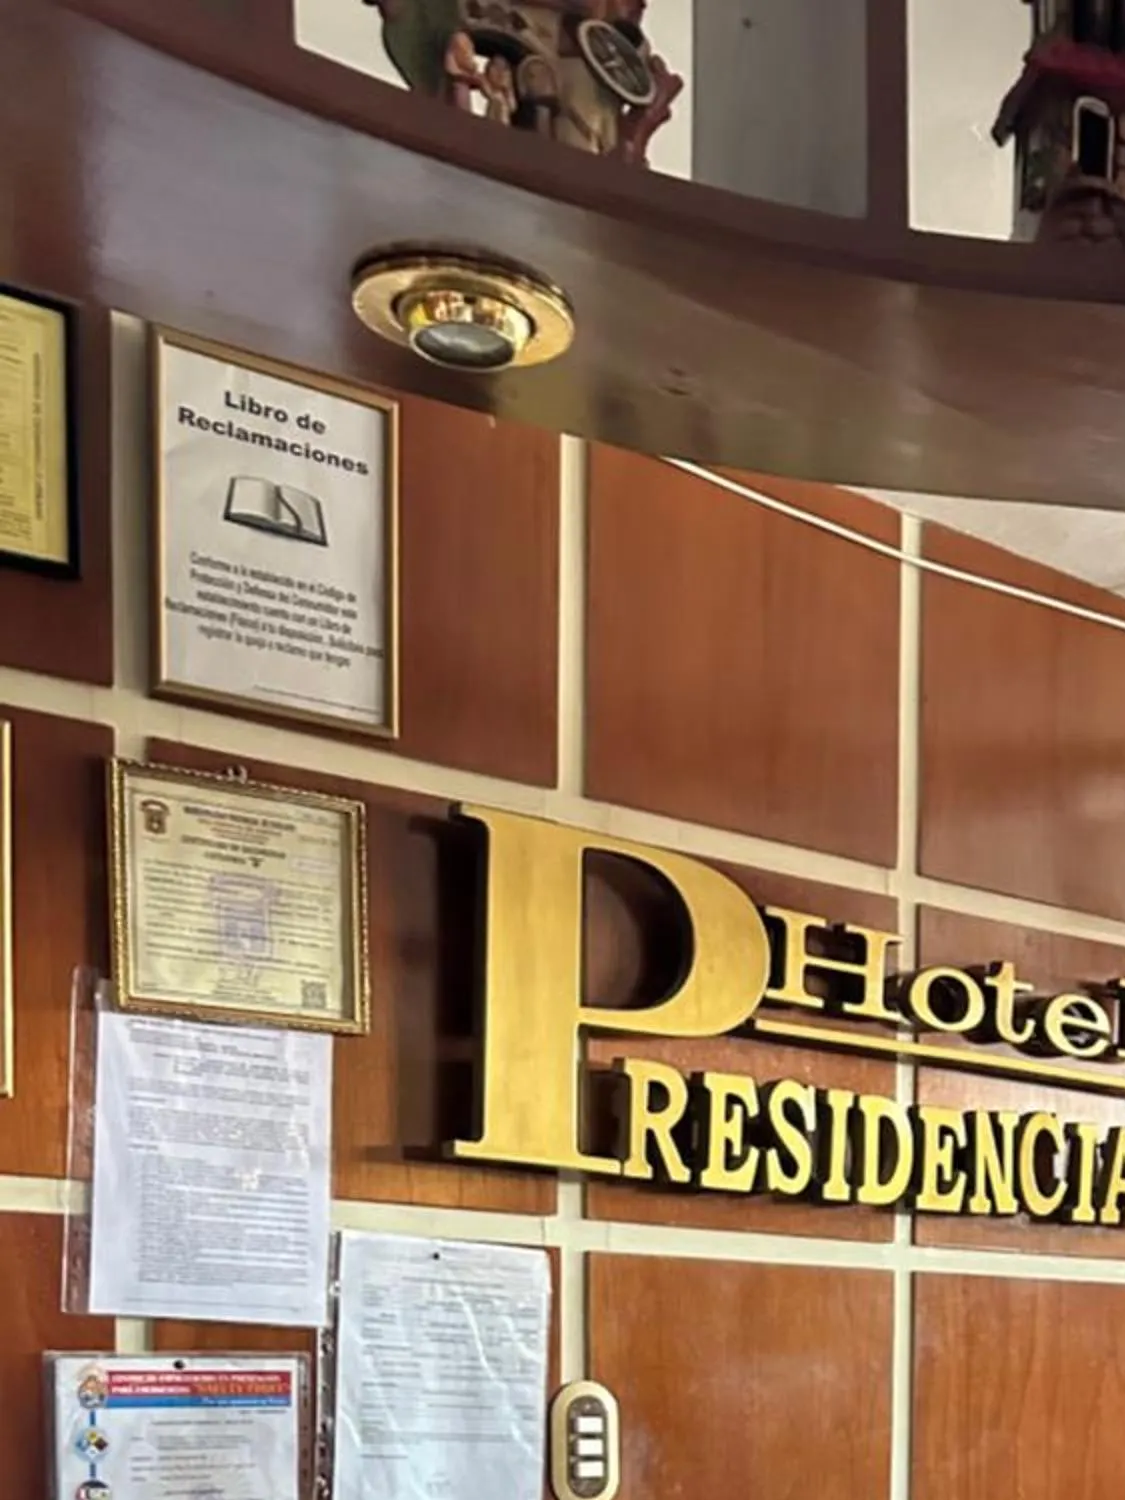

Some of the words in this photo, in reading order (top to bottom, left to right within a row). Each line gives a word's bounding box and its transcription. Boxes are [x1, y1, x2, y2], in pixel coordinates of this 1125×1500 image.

[177, 405, 370, 476] Reclamaciones
[224, 390, 289, 424] Libro
[296, 413, 327, 435] de
